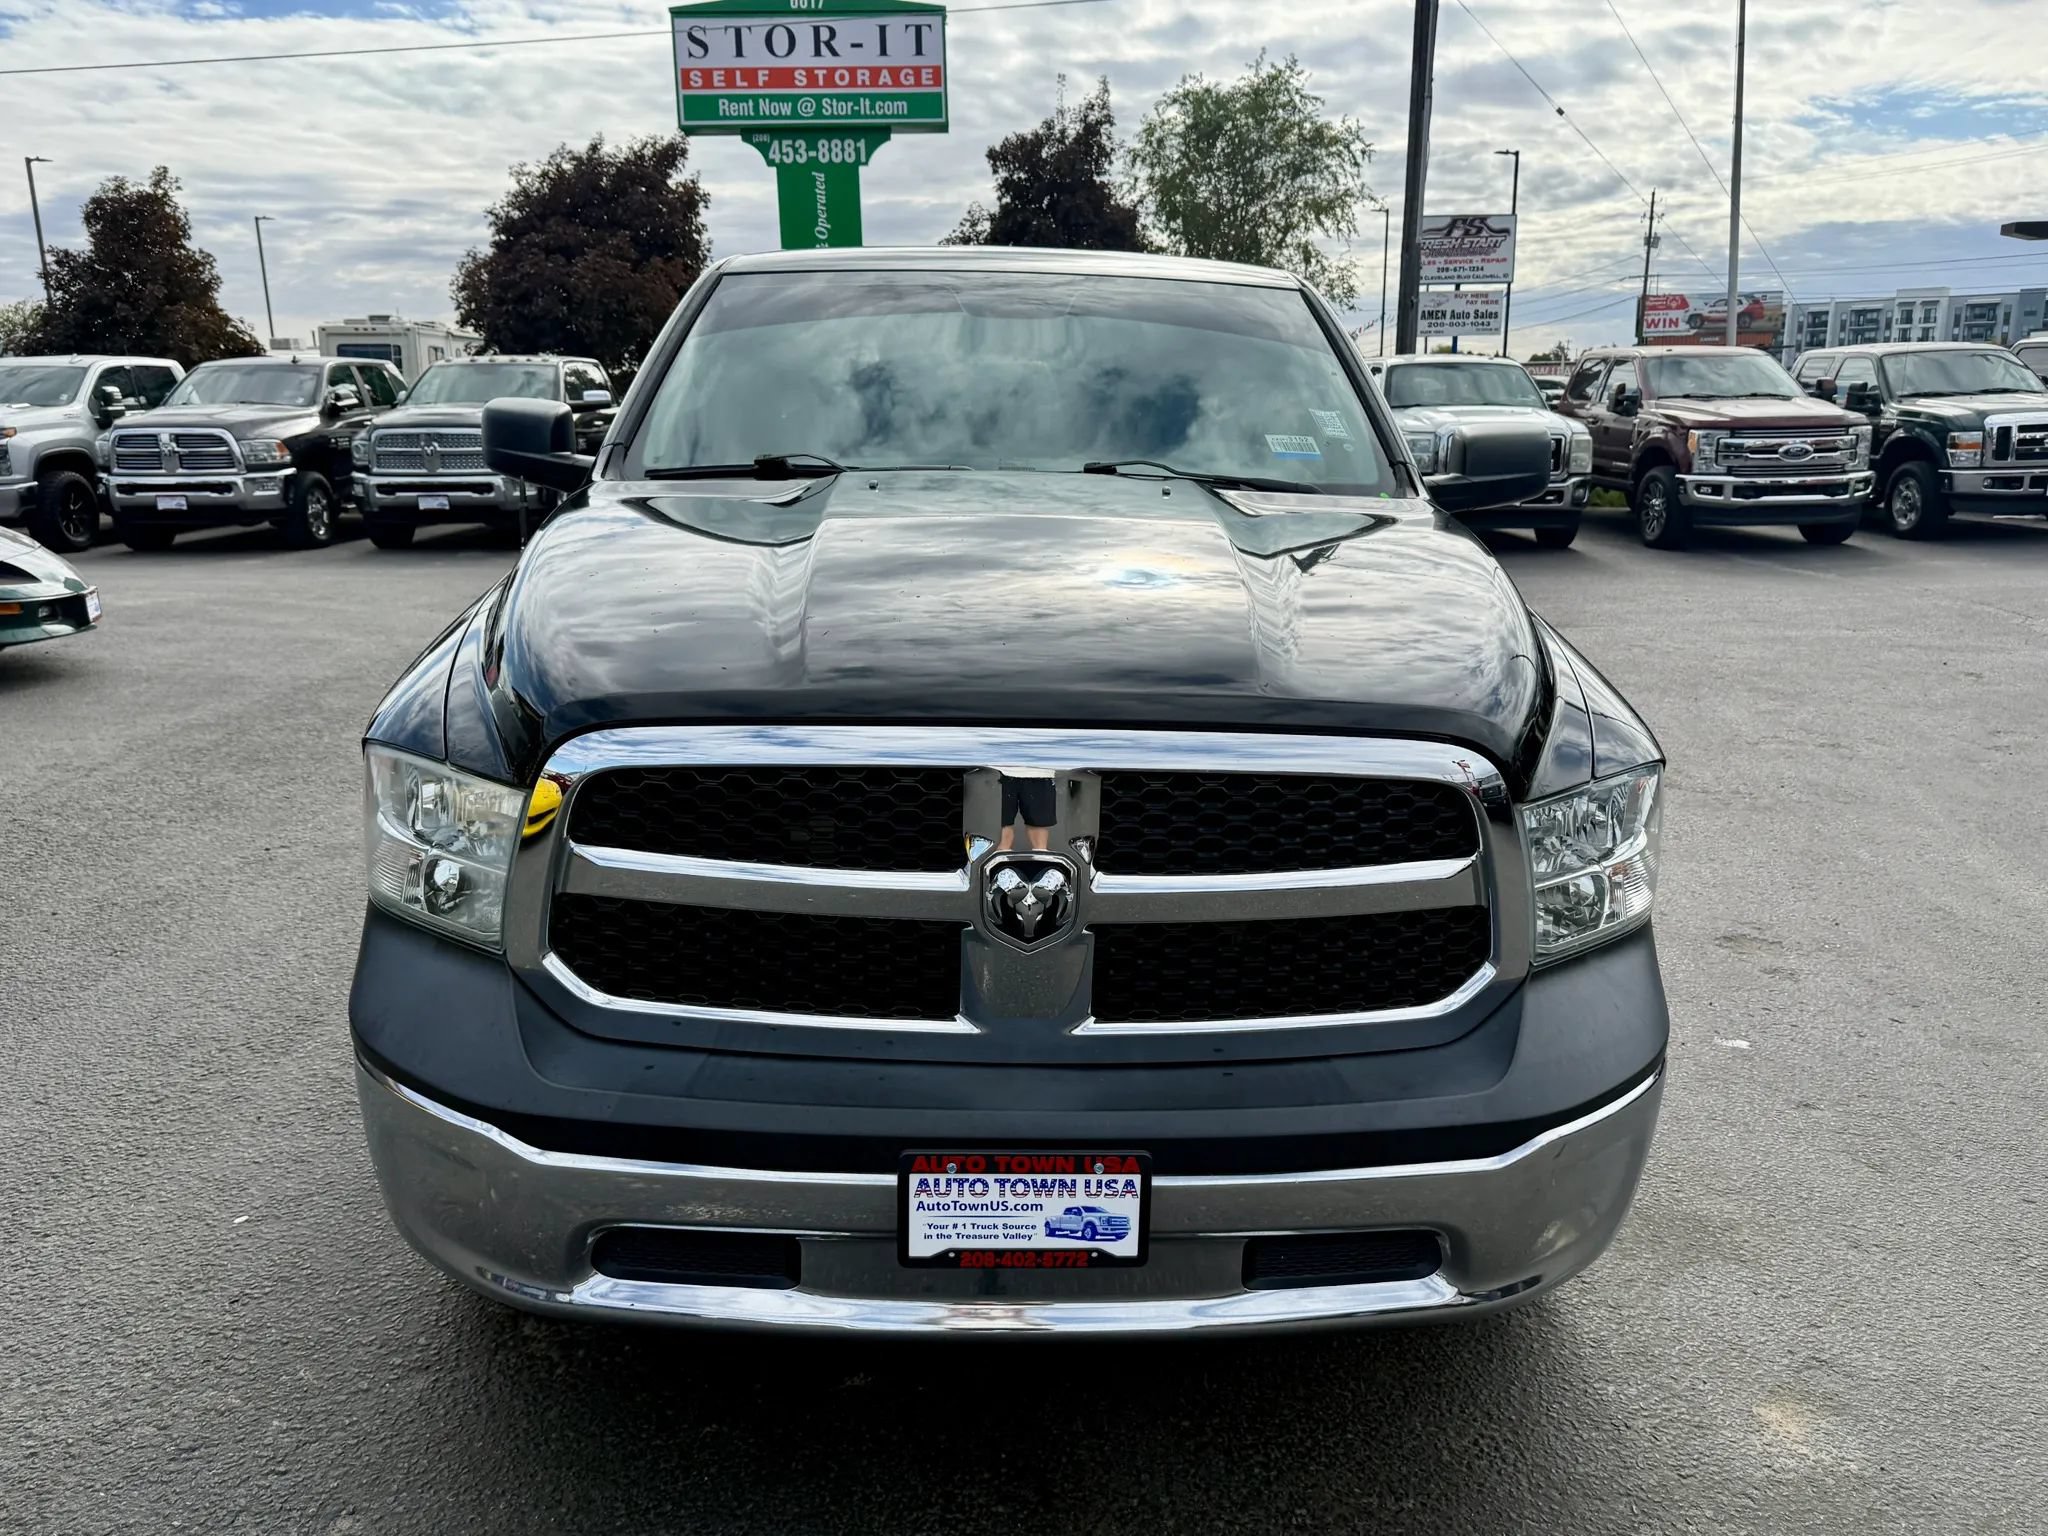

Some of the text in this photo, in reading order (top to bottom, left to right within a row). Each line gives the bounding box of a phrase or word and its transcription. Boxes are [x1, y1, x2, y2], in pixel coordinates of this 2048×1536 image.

[687, 24, 933, 59] STOR-IT
[689, 67, 935, 88] SELF STORAGE
[718, 96, 908, 118] Rent Now @ Stor-It.com
[768, 138, 867, 164] 453-8881
[811, 171, 832, 240] Operated
[1420, 308, 1499, 321] AMEN Auto Sales
[1645, 317, 1680, 329] WIN
[911, 1155, 1140, 1173] AUTO TOWN USA
[914, 1177, 1139, 1198] AUTO TOWN USA
[916, 1200, 1043, 1212] AutoTownUS.com
[923, 1232, 933, 1240] in
[936, 1232, 952, 1240] the
[955, 1232, 1000, 1240] Treasure
